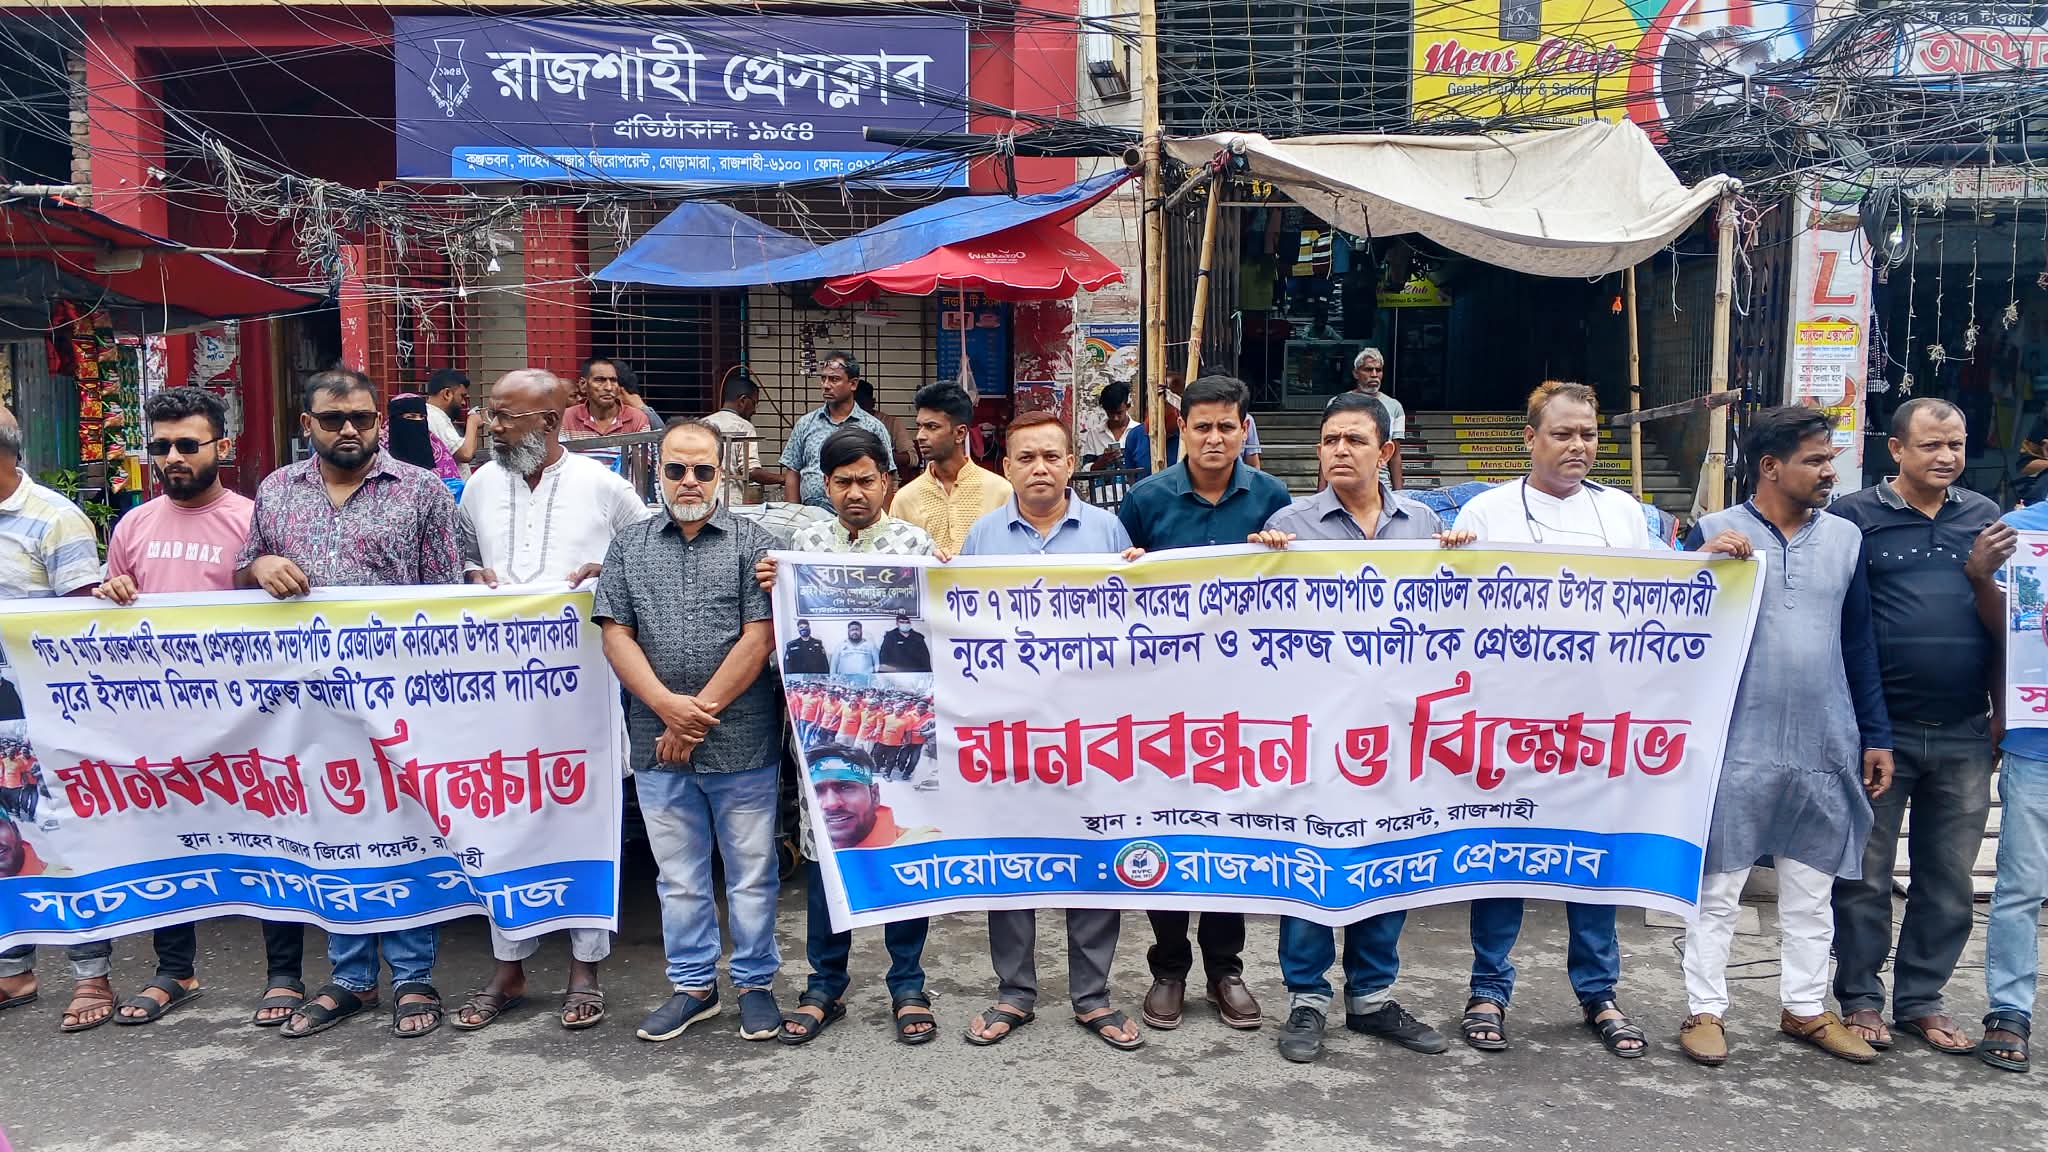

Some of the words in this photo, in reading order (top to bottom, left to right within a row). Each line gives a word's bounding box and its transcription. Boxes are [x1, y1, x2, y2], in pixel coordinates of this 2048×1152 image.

[486, 33, 708, 106] রাজশাহী
[723, 48, 934, 108] প্রেসক্লাব
[1424, 40, 1519, 76] Mens
[1535, 38, 1623, 75] Club
[1448, 83, 1483, 96] Gents
[1488, 82, 1536, 96] Parlour
[1552, 83, 1594, 96] Saloon
[748, 121, 814, 142] ১৯৫৪
[1604, 476, 1631, 485] Saloon
[147, 541, 183, 559] MAD
[185, 543, 223, 564] MAX
[946, 587, 979, 622] গত
[988, 593, 1000, 621] ৭
[1007, 578, 1042, 619] মার্চ
[1049, 576, 1129, 621] রাজশাহী
[1133, 582, 1191, 621] বরেন্দ্র
[1199, 574, 1298, 619] প্রেসক্লাবের
[1305, 566, 1386, 614] সভাপতি
[1394, 567, 1470, 615] রেজাউল
[1477, 565, 1552, 613] করিমের
[1558, 568, 1606, 614] উপর
[1612, 568, 1717, 618] হামলাকারী
[32, 634, 59, 667] গত
[60, 640, 78, 666] ৭
[72, 623, 102, 667] মার্চ
[101, 621, 154, 672] রাজশাহী
[160, 635, 202, 670] বরেন্দ্র
[203, 626, 270, 668] প্রেসক্লাবের
[276, 616, 332, 664] সভাপতি
[337, 613, 397, 662] রেজাউল
[402, 610, 459, 660] করিমের
[462, 607, 500, 654] উপর
[504, 603, 579, 656] হামলাকারী
[950, 637, 1007, 683] নূরে
[1014, 626, 1120, 675] ইসলাম
[1125, 622, 1206, 668] মিলন
[1214, 627, 1238, 659] ও
[1249, 627, 1335, 671] সুরুজ
[1473, 628, 1601, 665] গ্রেপ্তারের
[1608, 619, 1713, 666] দাবিতে
[46, 682, 89, 724] নূরে
[91, 670, 163, 716] ইসলাম
[165, 668, 220, 712] মিলন
[226, 679, 244, 708] ও
[248, 677, 301, 716] সুরুজ
[404, 670, 498, 708] গ্রেপ্তারের
[502, 656, 580, 698] দাবিতে
[954, 711, 1312, 792] মানববন্ধন
[1335, 724, 1390, 788] ও
[1409, 670, 1692, 791] বিক্ষোভ
[54, 747, 310, 820] মানববন্ধন
[321, 758, 365, 815] ও
[369, 718, 587, 838] বিক্ষোভ
[1151, 807, 1220, 828] সাহেব
[1229, 811, 1297, 834] বাজার
[1304, 814, 1367, 839] জিরো
[1447, 797, 1539, 823] রাজশাহী
[229, 831, 273, 850] সাহেব
[276, 836, 310, 859] বাজার
[314, 836, 360, 861] জিরো
[892, 852, 1083, 891] আয়োজনে
[1170, 841, 1334, 901] রাজশাহী
[1343, 849, 1443, 887] বরেন্দ্র
[1452, 839, 1608, 879] প্রেসক্লাব
[20, 867, 221, 921] সচেতন
[239, 868, 413, 913] নাগরিক
